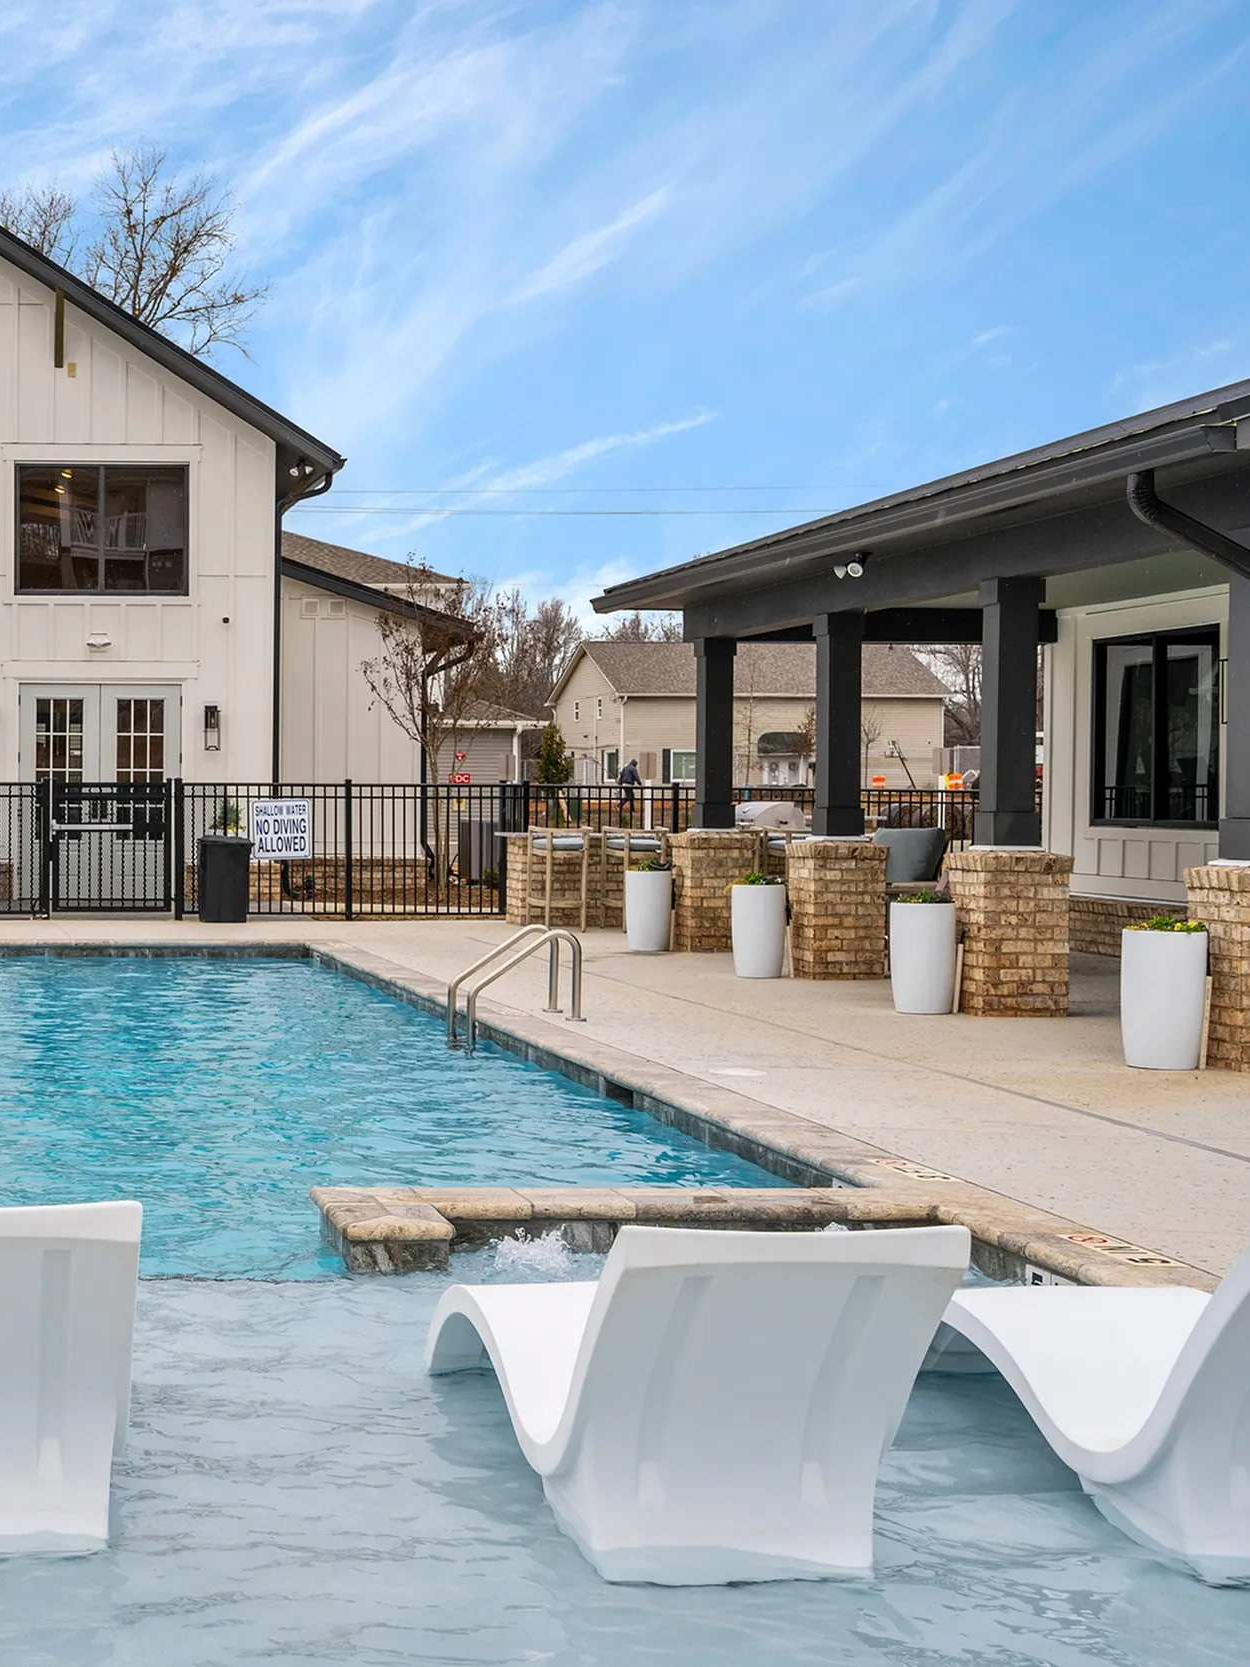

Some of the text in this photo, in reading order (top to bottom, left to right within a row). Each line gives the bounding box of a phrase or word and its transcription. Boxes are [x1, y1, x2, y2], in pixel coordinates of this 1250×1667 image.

[255, 804, 306, 816] SHALLOW WATER
[256, 818, 306, 835] NO DIVING
[257, 836, 307, 853] ALLOWED
